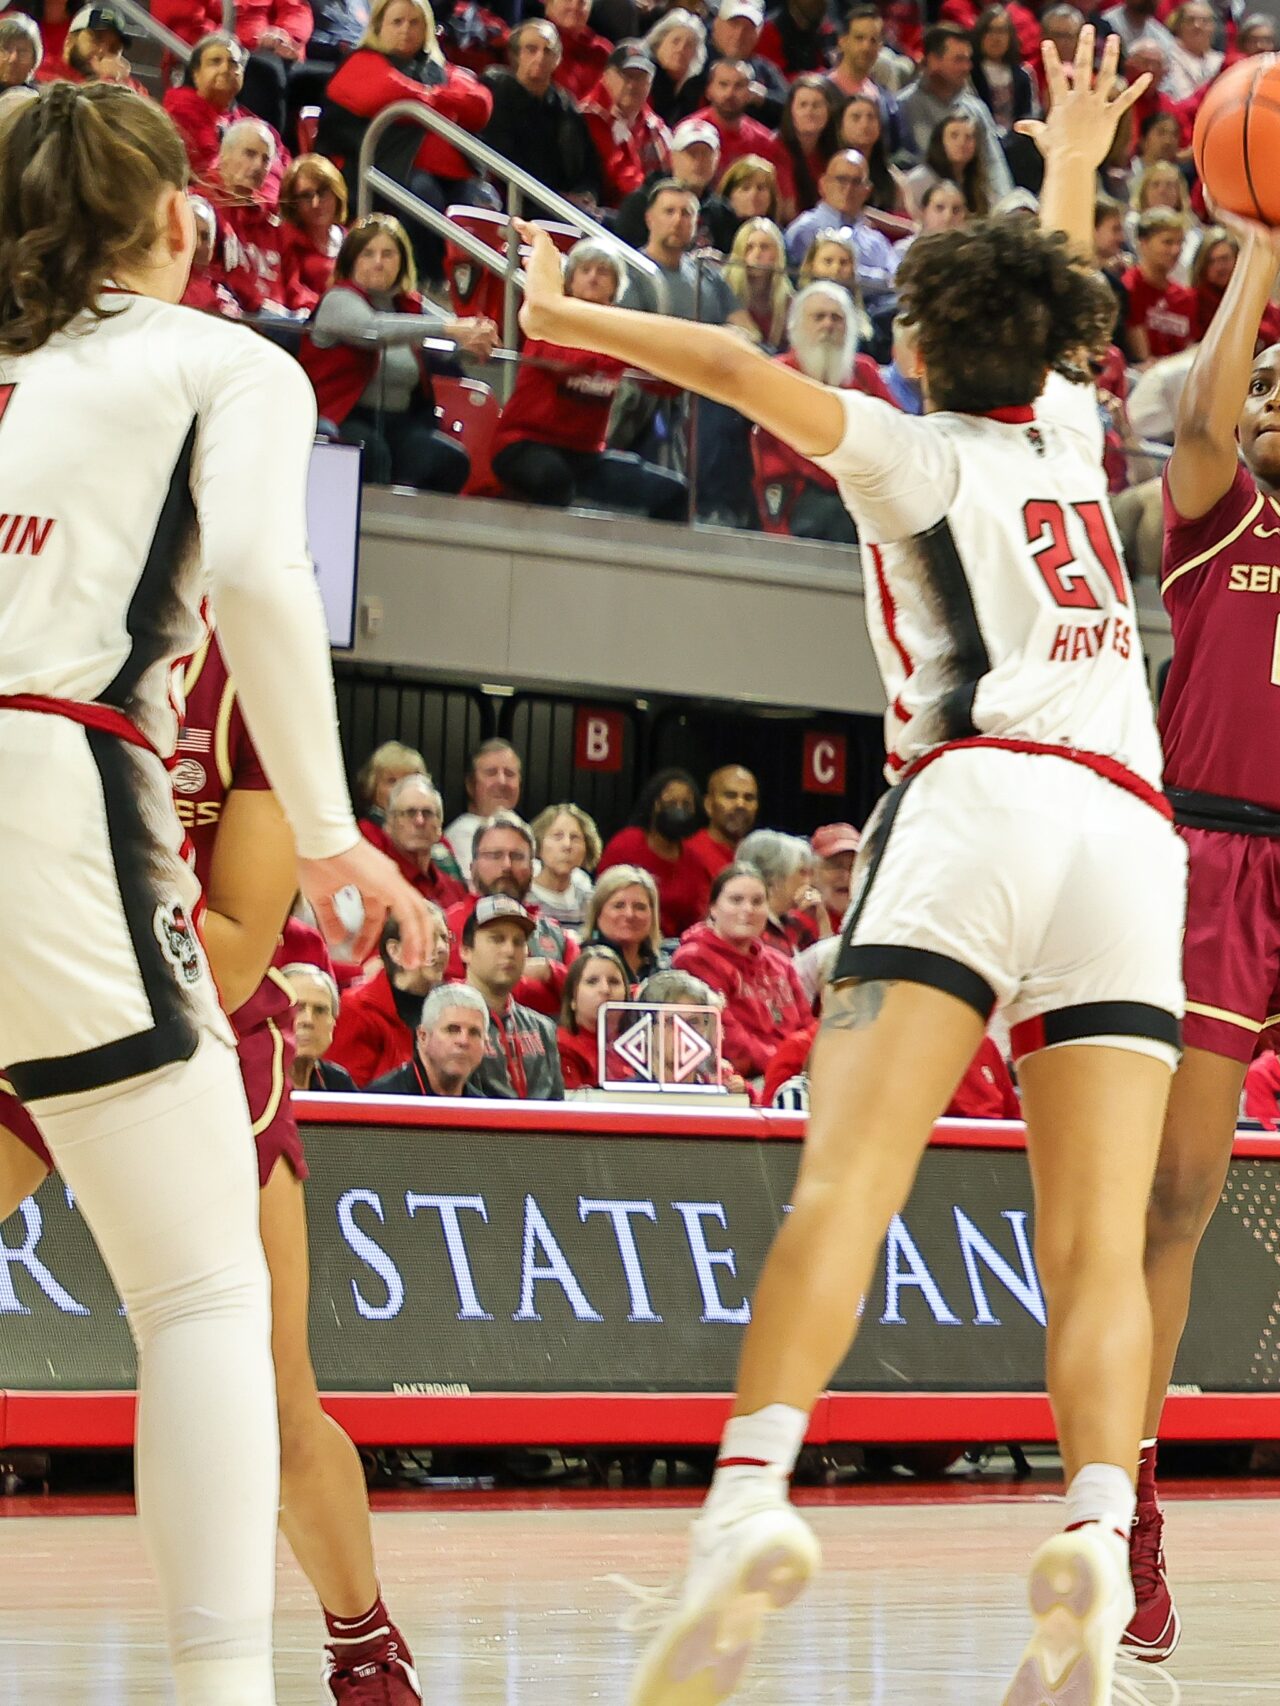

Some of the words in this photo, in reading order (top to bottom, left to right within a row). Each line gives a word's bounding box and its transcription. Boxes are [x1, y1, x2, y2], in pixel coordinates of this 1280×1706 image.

[1022, 498, 1129, 610] 21
[587, 716, 610, 762] B
[812, 740, 836, 784] C
[336, 1187, 753, 1325] STATE
